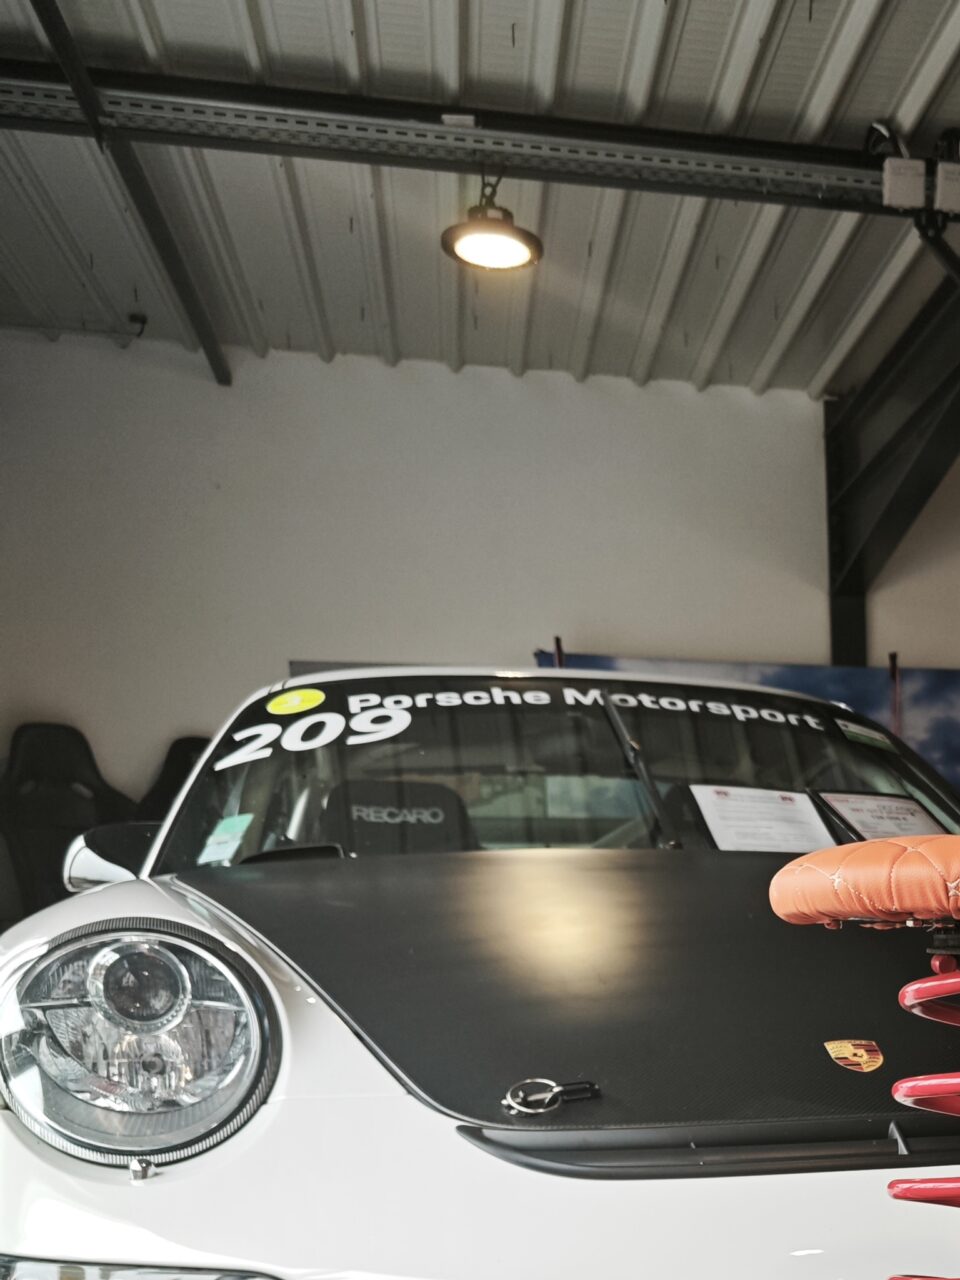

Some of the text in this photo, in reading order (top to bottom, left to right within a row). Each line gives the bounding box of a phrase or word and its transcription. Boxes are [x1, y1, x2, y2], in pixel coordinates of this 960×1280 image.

[348, 686, 551, 714] Porsche
[562, 687, 825, 731] Motorsport
[213, 712, 412, 771] 209
[351, 804, 445, 824] RECARO
